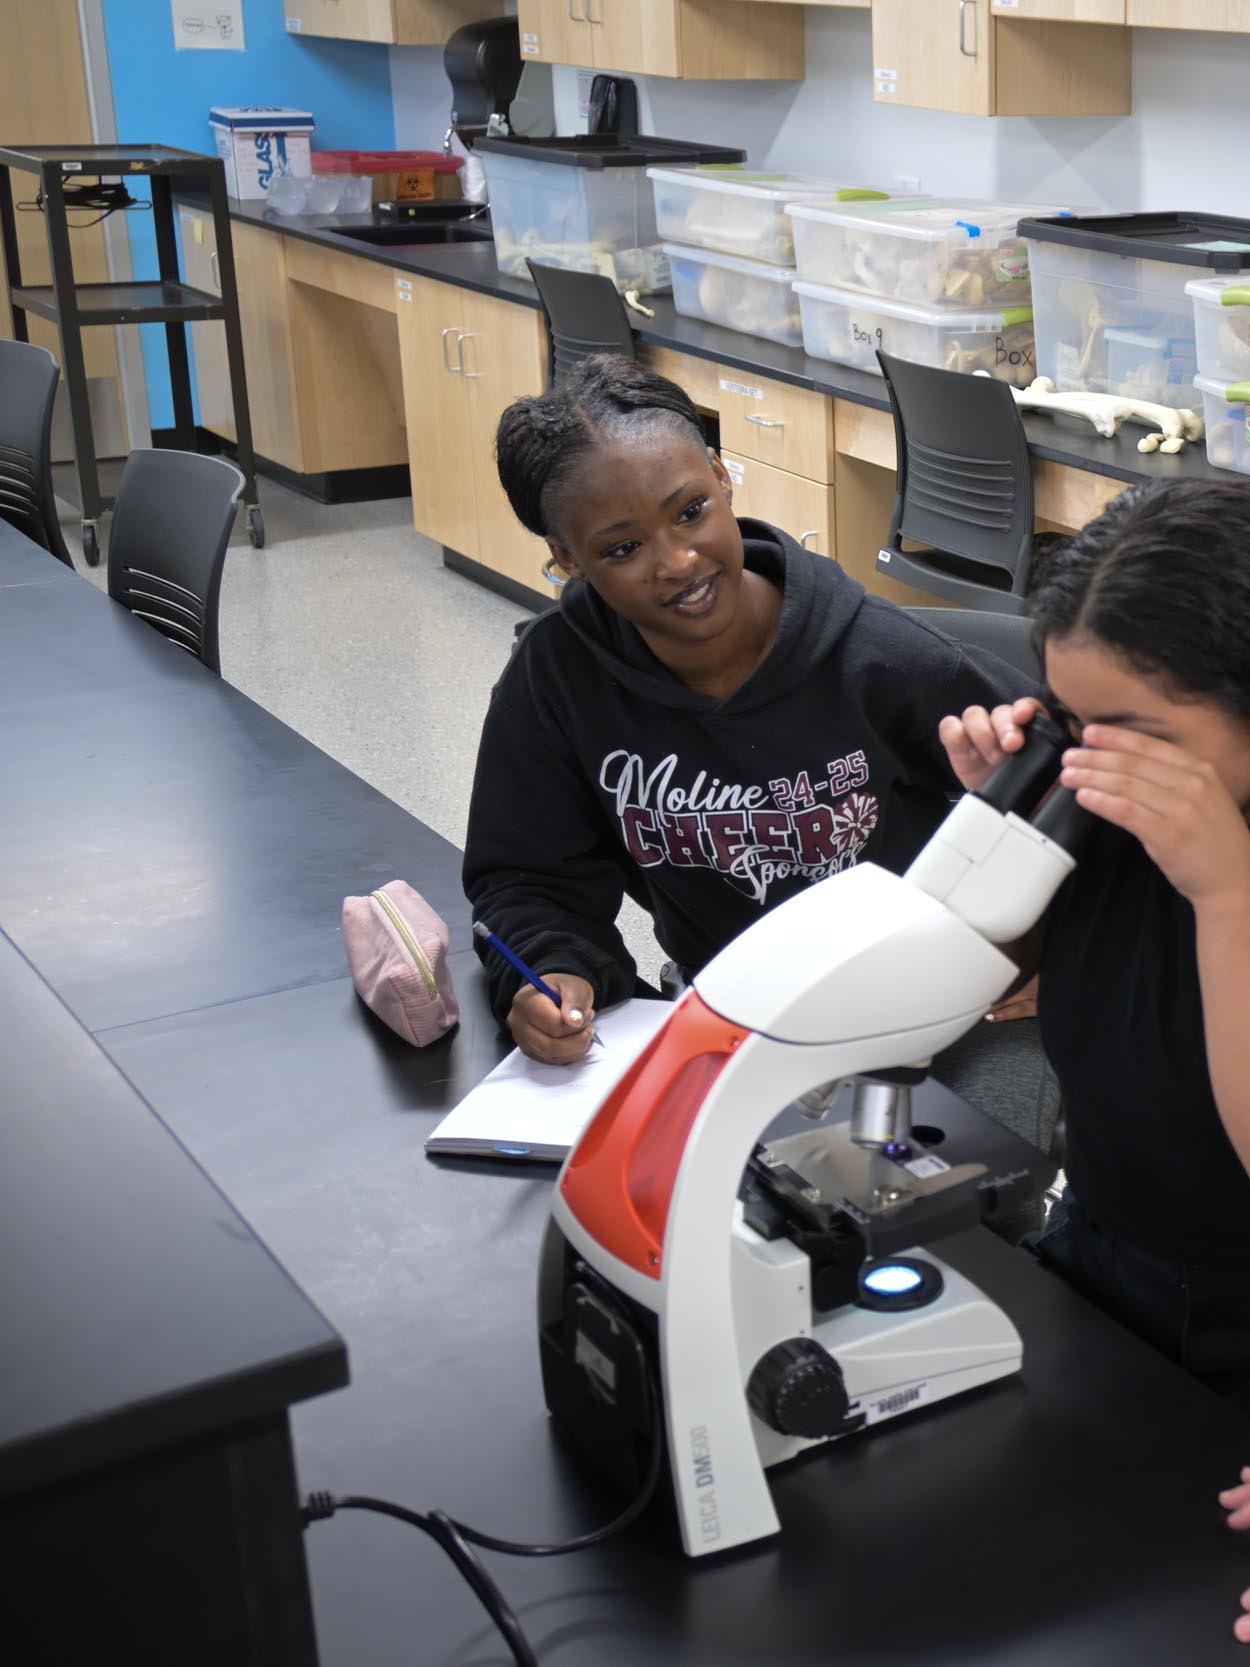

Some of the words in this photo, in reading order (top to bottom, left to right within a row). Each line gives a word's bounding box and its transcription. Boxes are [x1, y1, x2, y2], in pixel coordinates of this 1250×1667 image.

[852, 323, 872, 345] Box
[875, 327, 883, 351] 9
[994, 336, 1034, 368] Box
[600, 750, 769, 828] Moline
[769, 750, 870, 811] 24-25
[619, 803, 839, 873] CHEER
[689, 1425, 714, 1488] DM500
[698, 1489, 721, 1544] LEICA
